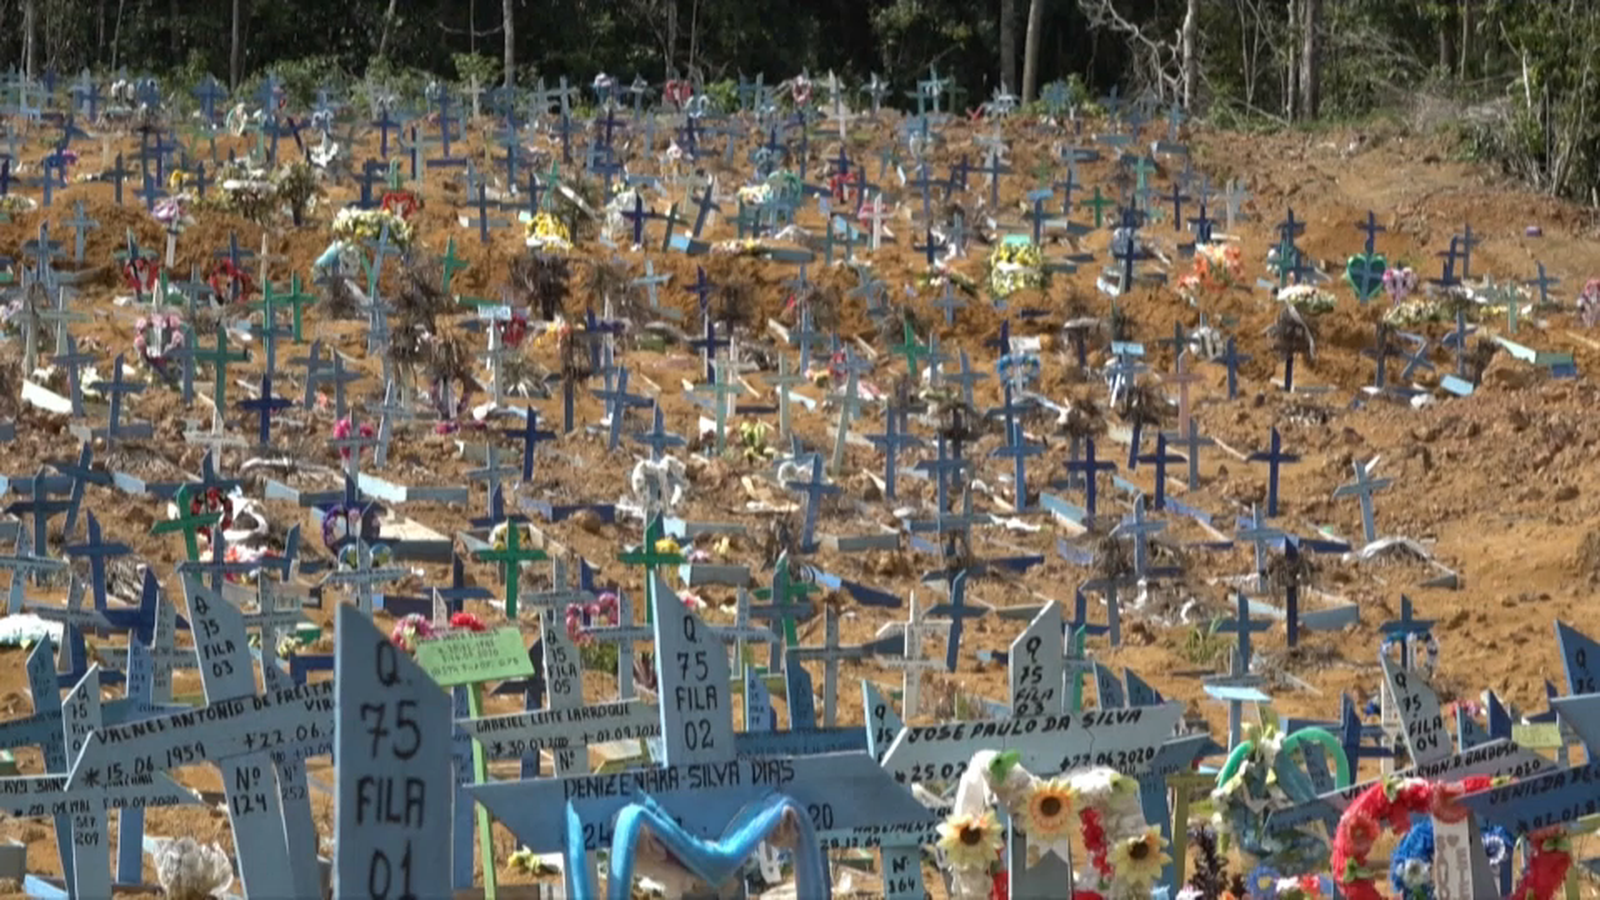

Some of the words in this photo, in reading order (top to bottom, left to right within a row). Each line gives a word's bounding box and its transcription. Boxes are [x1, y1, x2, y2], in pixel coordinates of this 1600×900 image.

[203, 639, 237, 661] FILA
[212, 659, 235, 678] 03
[677, 651, 709, 682] 75
[675, 685, 719, 713] FILA
[170, 700, 244, 729] ANTONIO
[476, 715, 525, 734] GABRIEL
[531, 711, 562, 727] LEITE
[568, 703, 632, 724] LARROQUE
[908, 723, 966, 744] JOSE
[970, 718, 1038, 741] PAULO
[1041, 715, 1071, 734] DA
[1081, 708, 1143, 730] SILVA
[1409, 716, 1443, 738] FILA
[360, 700, 421, 760] 75
[684, 719, 715, 750] 02
[1416, 734, 1438, 752] 04
[751, 756, 796, 785] DIAS
[233, 792, 268, 817] 124
[356, 776, 426, 829] FILA
[369, 839, 418, 900] 01
